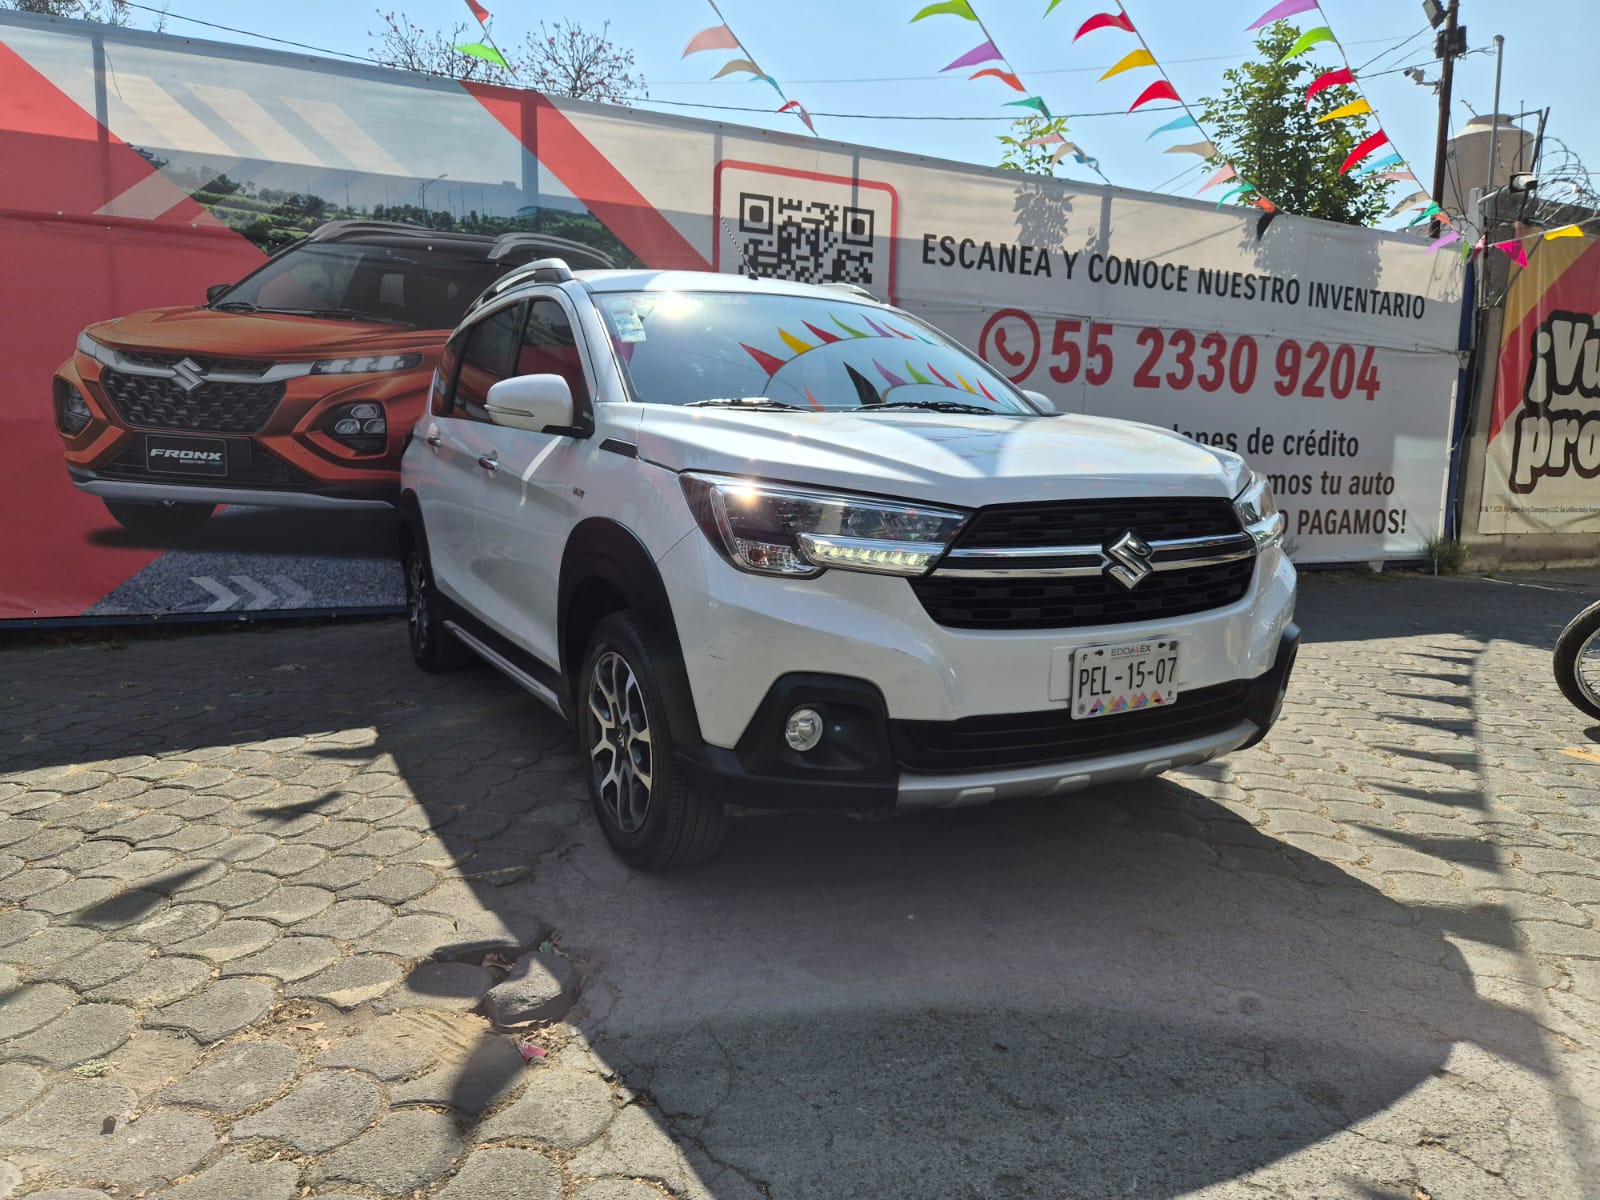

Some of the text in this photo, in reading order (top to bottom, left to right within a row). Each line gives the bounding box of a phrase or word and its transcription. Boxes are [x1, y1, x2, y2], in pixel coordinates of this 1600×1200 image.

[922, 233, 1425, 320] ESCANEA Y CONOCE NUESTRO INVENTARIO
[1048, 319, 1381, 401] 55 2330 9204
[149, 448, 223, 460] FRONX
[1247, 427, 1274, 455] de
[1283, 429, 1359, 458] crédito
[1321, 471, 1342, 495] tu
[1349, 472, 1396, 496] auto
[1297, 509, 1407, 535] PAGAMOS!
[1078, 656, 1178, 699] PEL-15-07
